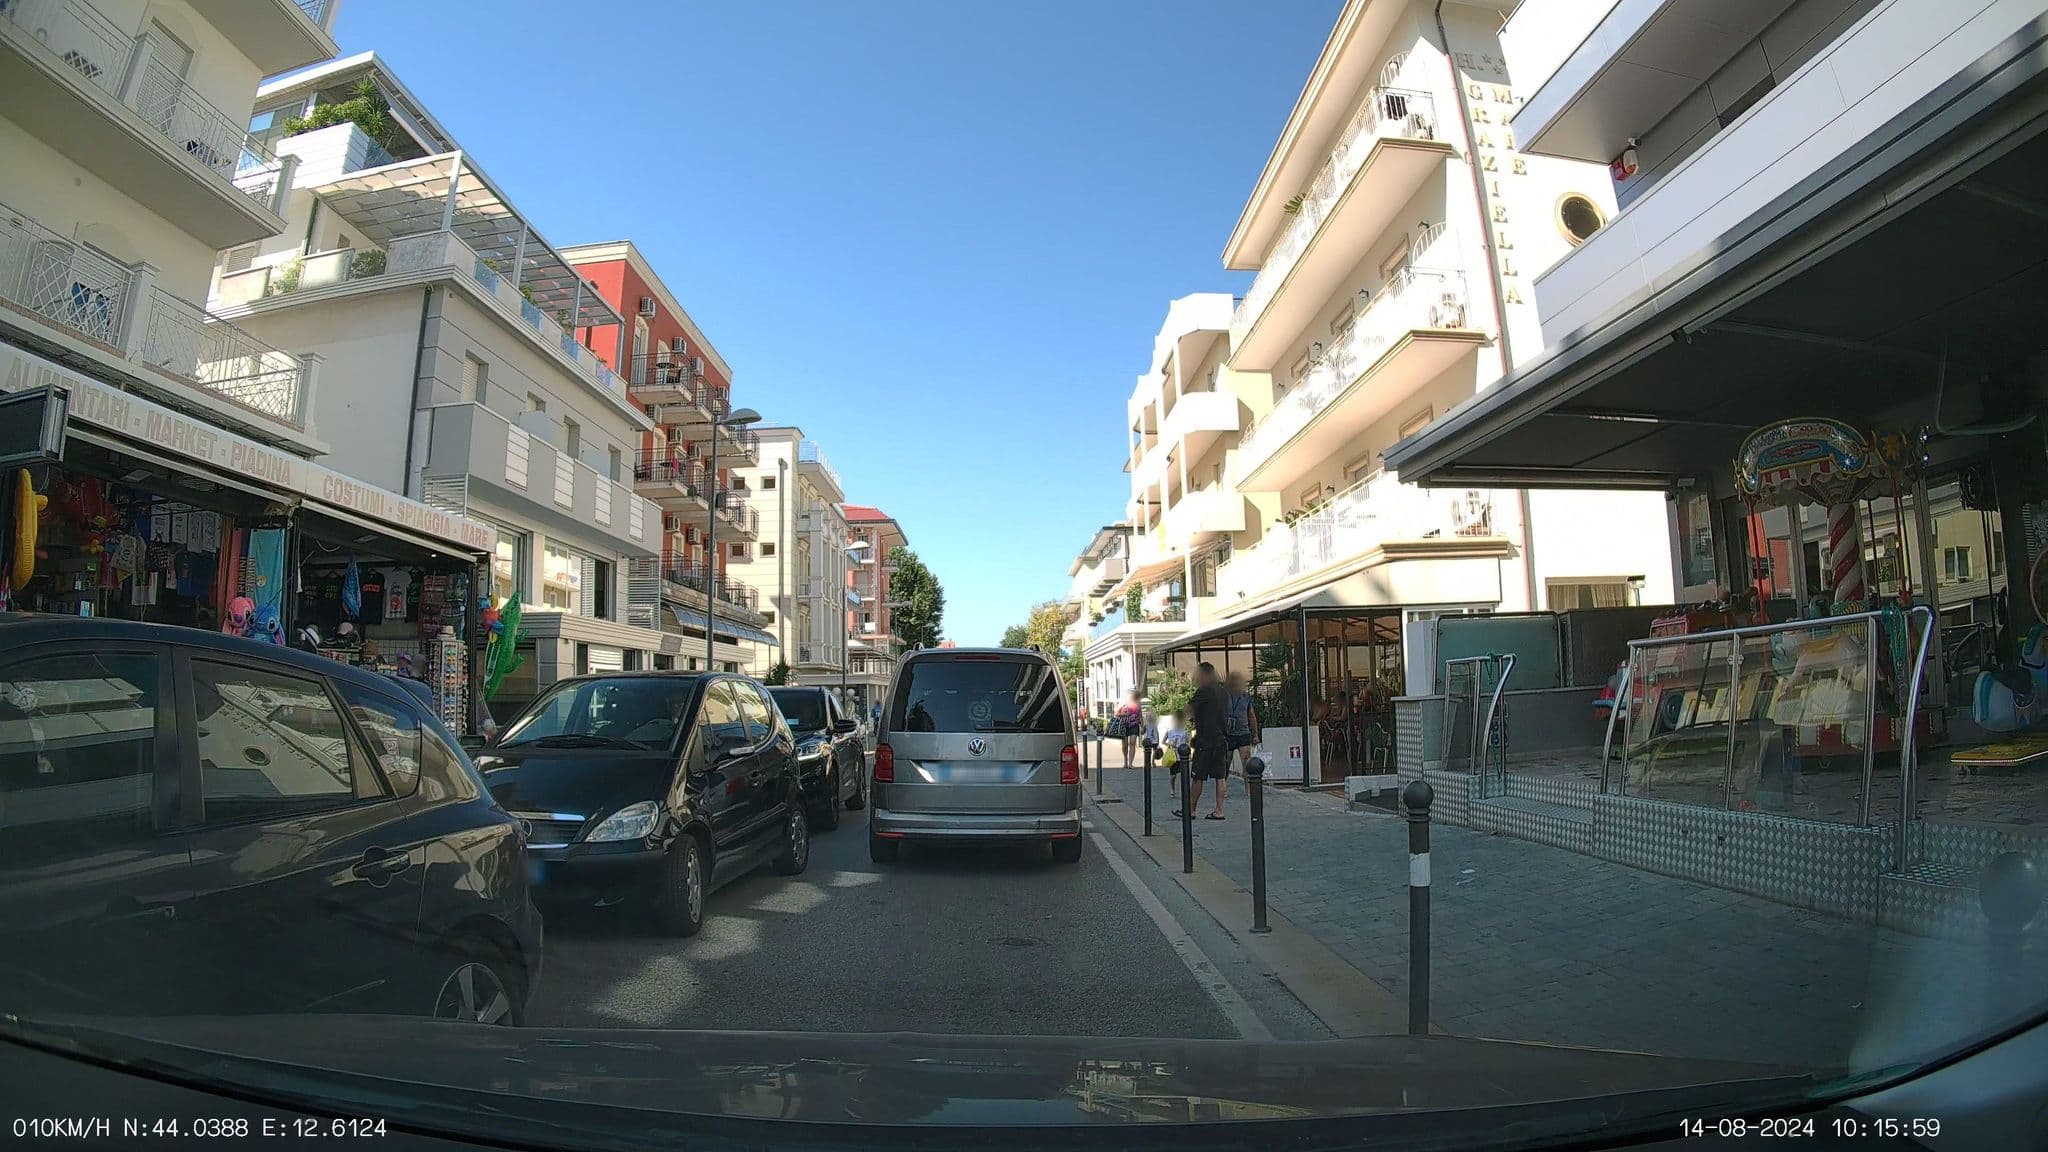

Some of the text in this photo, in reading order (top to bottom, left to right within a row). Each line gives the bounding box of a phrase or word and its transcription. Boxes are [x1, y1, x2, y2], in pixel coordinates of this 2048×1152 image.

[1468, 84, 1524, 304] GRAZIELLA
[146, 410, 218, 458] MARKET
[231, 441, 290, 486] PIADINA
[323, 474, 385, 515] COSTUMI
[397, 502, 450, 537] SPIAGGIA
[462, 523, 488, 547] MARE
[237, 556, 247, 593] RIMINI
